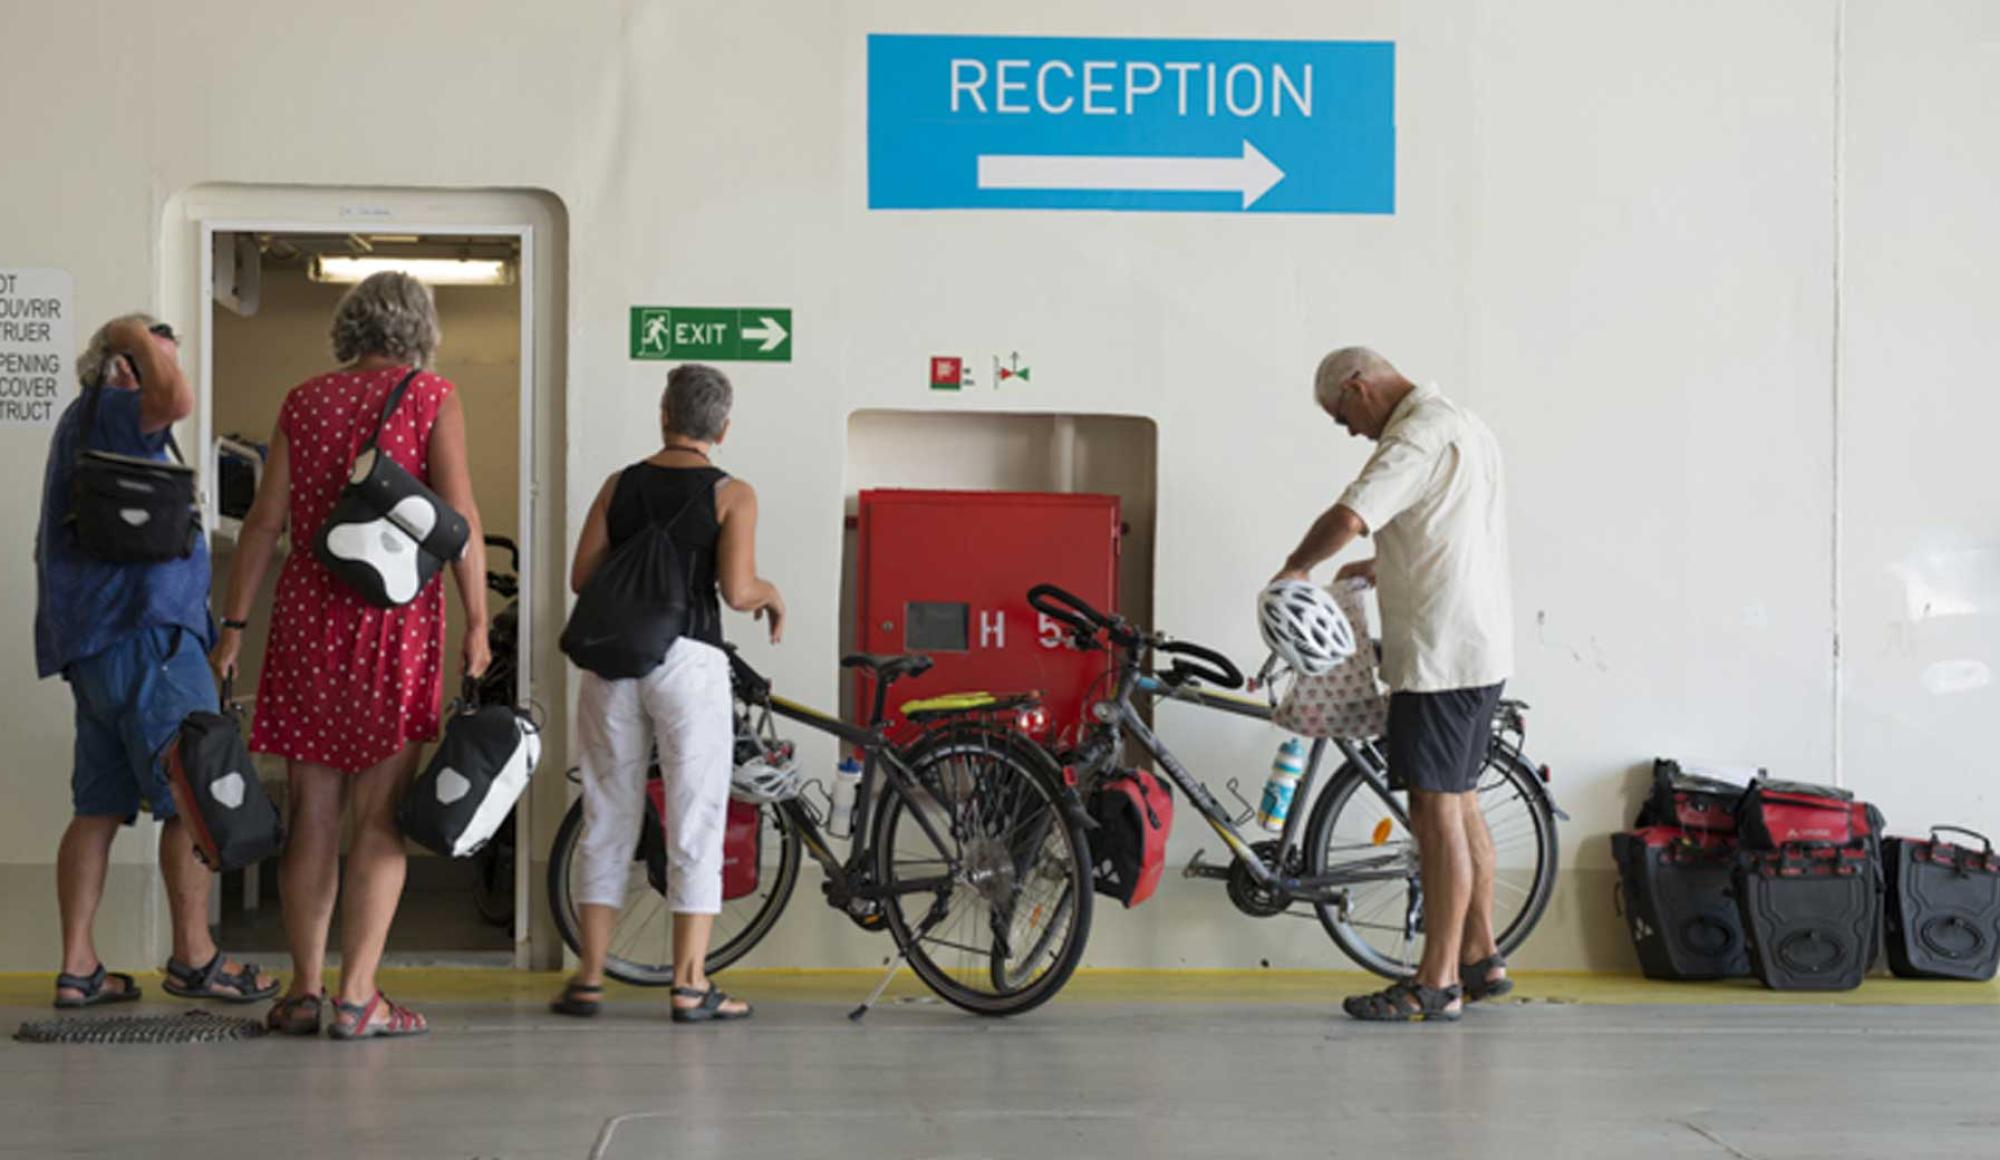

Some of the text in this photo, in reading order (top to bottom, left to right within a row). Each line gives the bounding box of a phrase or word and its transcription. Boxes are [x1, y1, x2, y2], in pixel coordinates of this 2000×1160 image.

[949, 58, 1315, 118] RECEPTION
[675, 322, 727, 345] EXIT
[0, 376, 58, 398] COVER
[980, 610, 1005, 648] H
